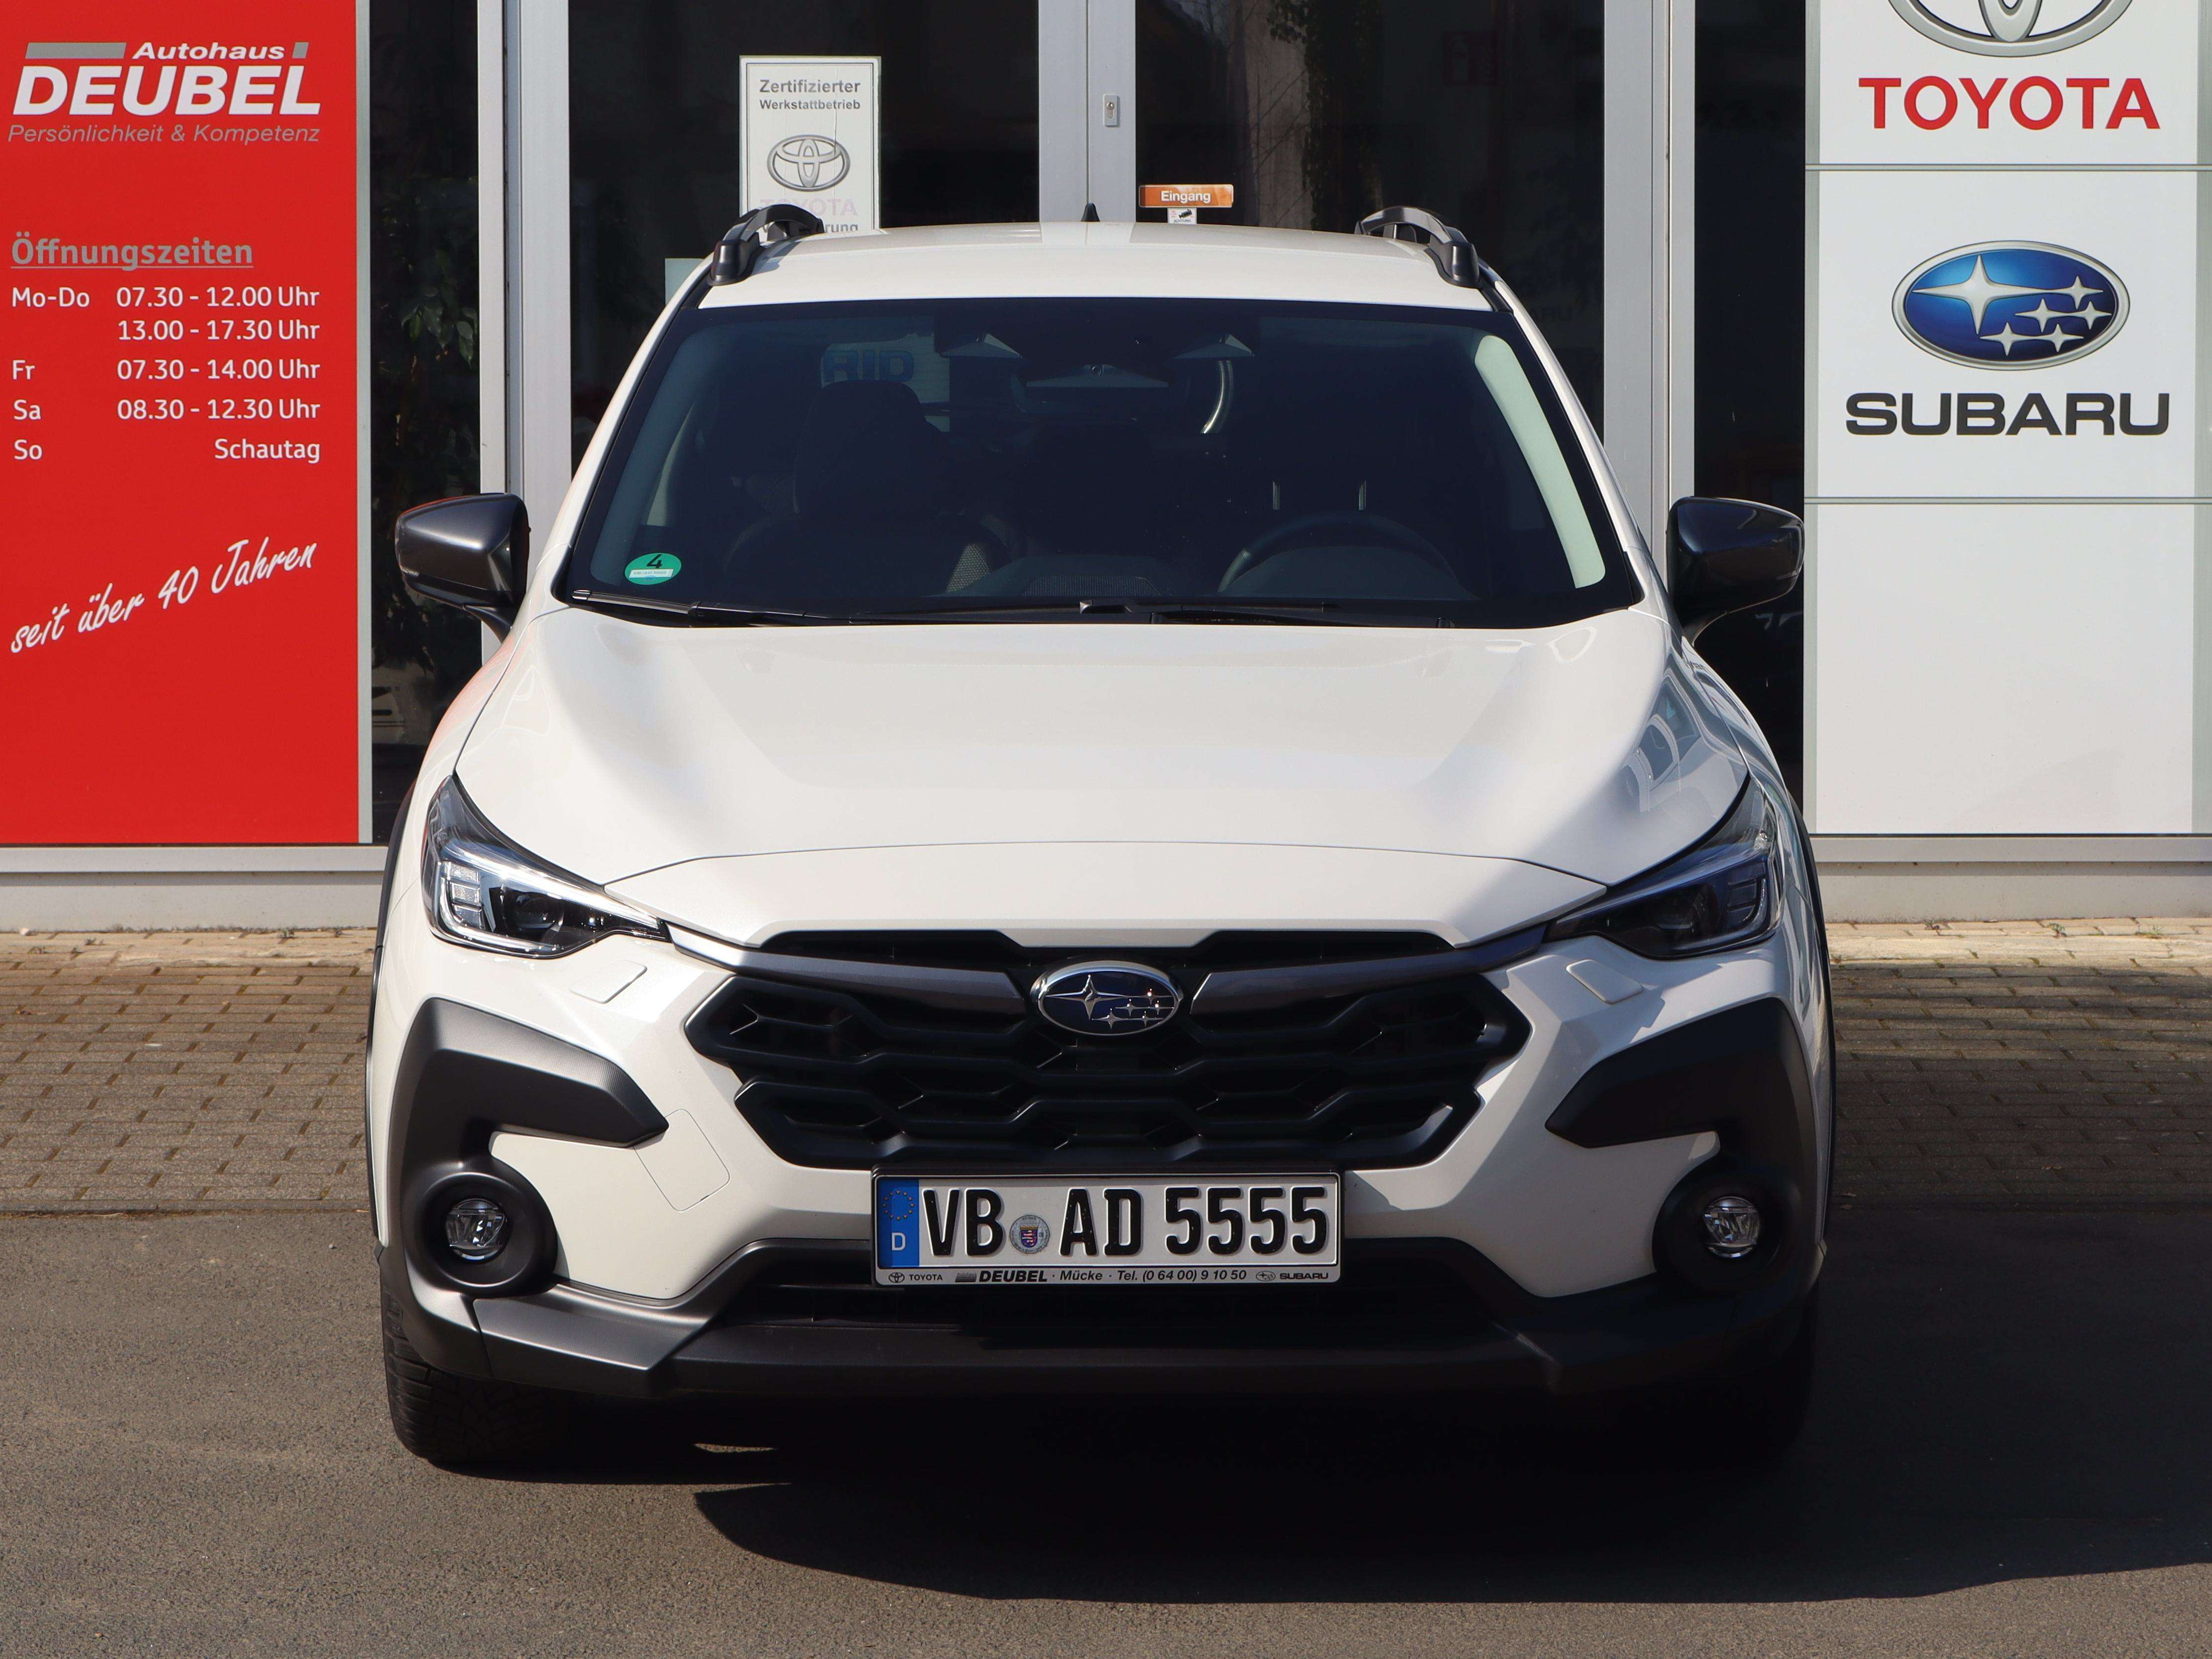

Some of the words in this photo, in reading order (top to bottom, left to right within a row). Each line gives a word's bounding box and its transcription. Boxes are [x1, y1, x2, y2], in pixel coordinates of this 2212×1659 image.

[132, 42, 285, 60] Autohaus
[13, 65, 321, 117] DEUBEL
[759, 80, 861, 93] Zertifizierter
[760, 99, 860, 110] Werkstattbetrieb
[1859, 76, 2161, 130] TOYOTA
[8, 124, 164, 142] Persönlichkeit
[171, 125, 185, 142] &
[193, 124, 320, 145] Kompetenz
[1161, 190, 1211, 204] Eingang
[11, 231, 254, 271] Öffnungszeiten
[12, 287, 90, 307] Mo-Do
[117, 287, 183, 306] 07.30
[208, 287, 272, 306] 12.00
[279, 286, 320, 306] Uhr
[118, 320, 183, 340] 13.00
[208, 320, 272, 340] 17.30
[279, 319, 320, 340] Uhr
[13, 360, 35, 380] Fr
[117, 359, 183, 379] 07.30
[208, 359, 272, 379] 14.00
[279, 359, 320, 379] Uhr
[14, 399, 41, 420] Sa
[117, 399, 183, 419] 08.30
[208, 399, 272, 419] 12.30
[279, 398, 320, 419] Uhr
[1846, 392, 2169, 435] SUBARU
[14, 439, 43, 460] So
[215, 438, 320, 464] Schautag
[646, 554, 662, 568] 4
[11, 603, 70, 653] seit
[78, 583, 145, 633] über
[158, 565, 199, 609] 40
[211, 536, 317, 594] Jahren
[923, 1189, 1004, 1256] VB
[1059, 1189, 1141, 1256] AD
[1165, 1187, 1327, 1255] 5555
[892, 1233, 906, 1251] D
[979, 1270, 1047, 1282] DEUBEL
[1059, 1270, 1103, 1281] Mücke
[1117, 1270, 1138, 1280] Tel.
[1142, 1270, 1155, 1282] (0
[1158, 1270, 1174, 1280] 64
[1177, 1270, 1197, 1281] 00)
[1201, 1270, 1209, 1280] 9
[1213, 1270, 1228, 1280] 10
[1230, 1270, 1247, 1280] 50
